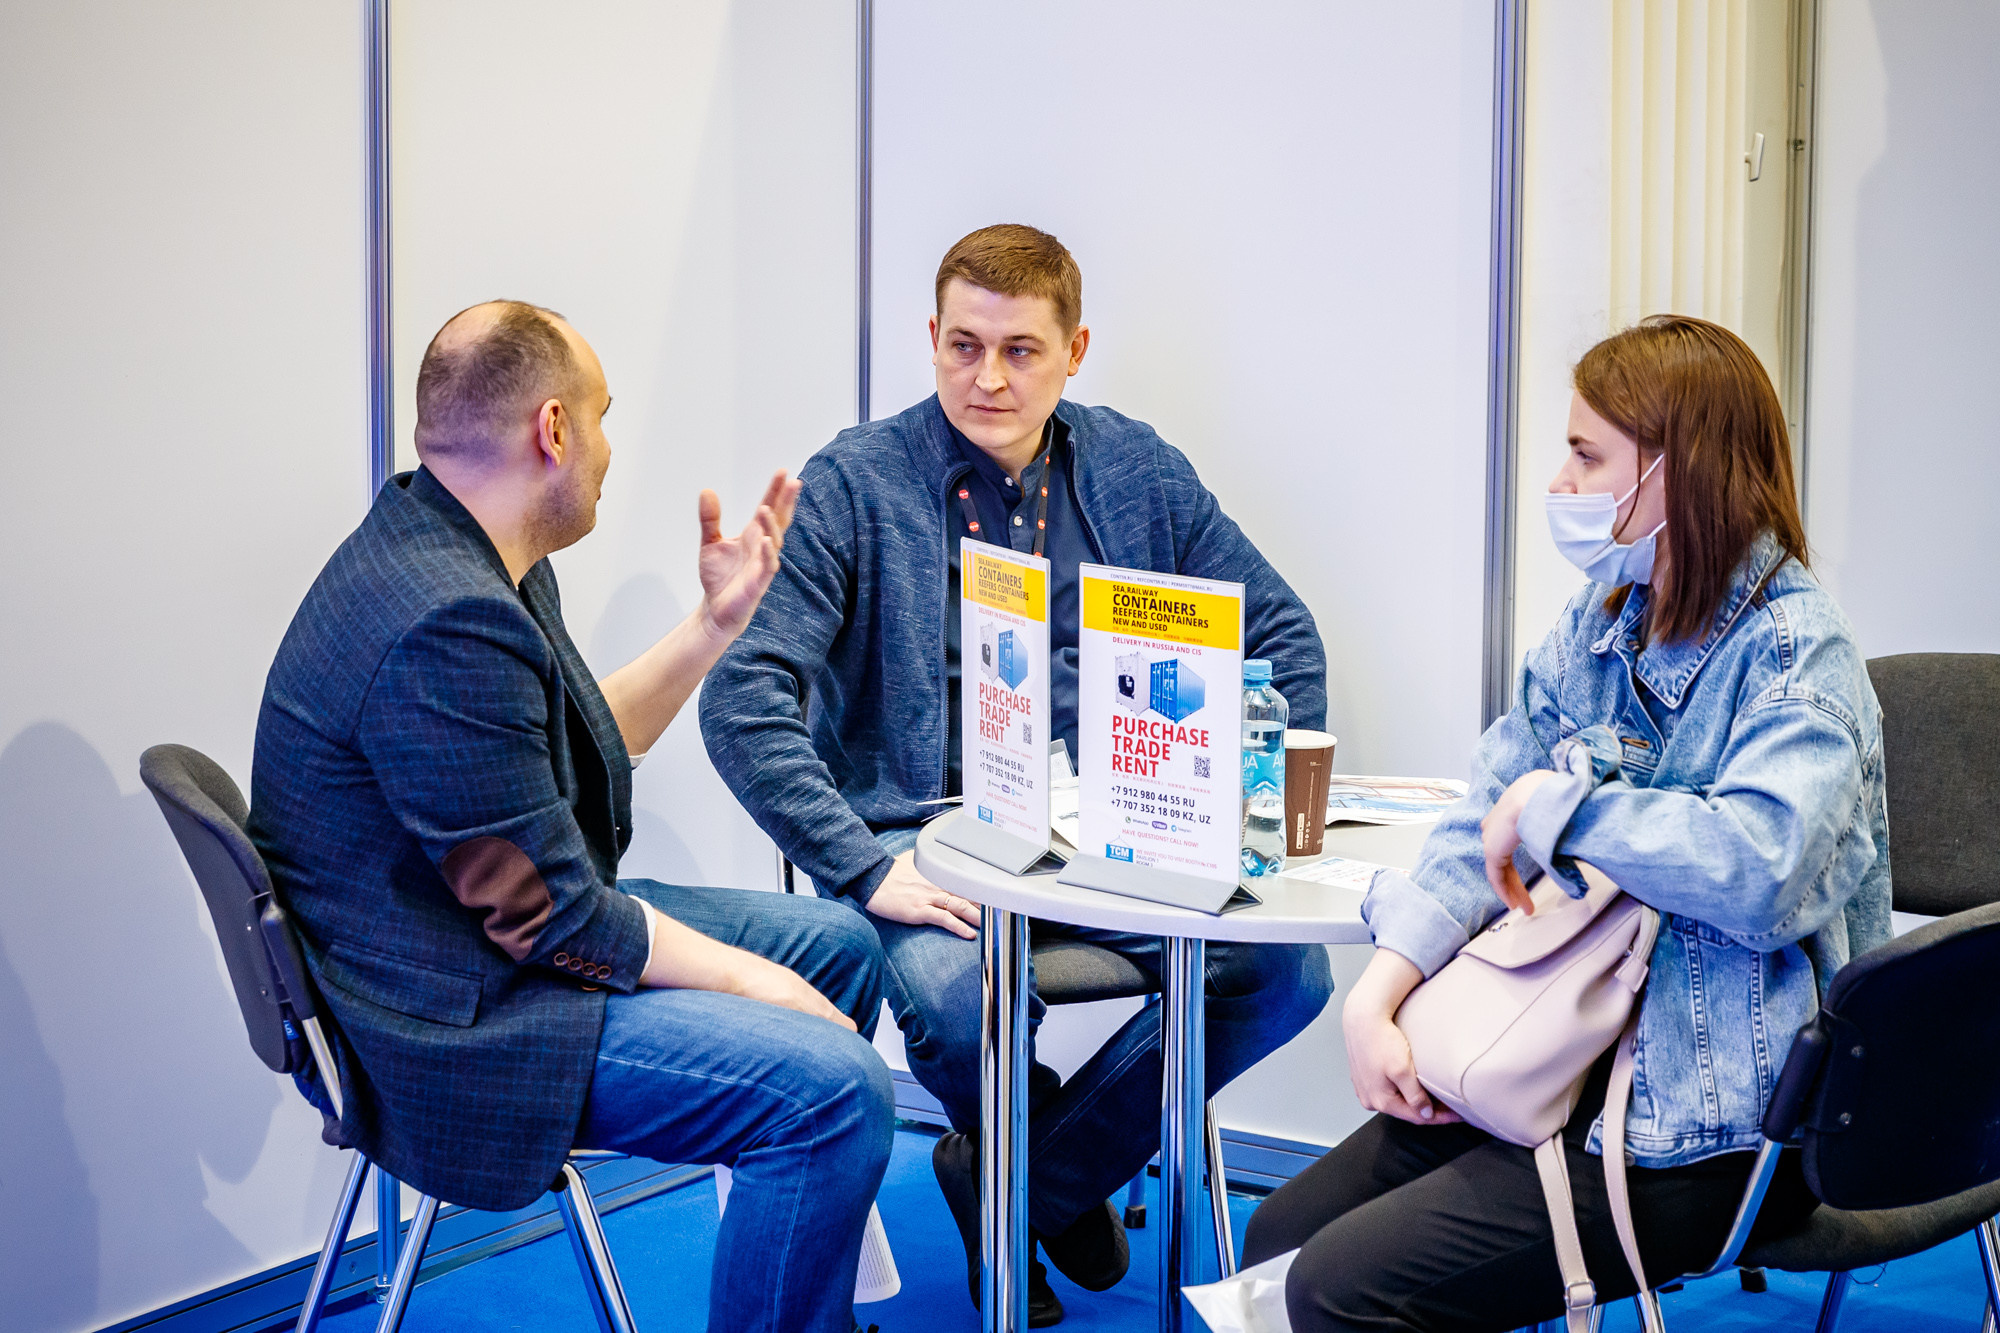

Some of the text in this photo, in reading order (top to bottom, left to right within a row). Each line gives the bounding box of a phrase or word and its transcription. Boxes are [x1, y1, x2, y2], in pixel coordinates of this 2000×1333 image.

[978, 566, 1022, 589] CONTAINERS
[978, 578, 1029, 601] REEFERS CONTAINERS
[978, 588, 1007, 603] NEW AND USED
[978, 606, 994, 617] DELIVERY
[1113, 593, 1196, 616] CONTAINERS
[1113, 607, 1209, 628] REEFERS CONTAINERS
[1113, 618, 1168, 632] NEW AND USED
[1112, 636, 1141, 646] DELIVERY
[1152, 643, 1174, 651] RUSSIA
[1176, 646, 1190, 654] AND
[1192, 648, 1202, 656] CIS
[979, 682, 1030, 715] PURCHASE
[979, 700, 1010, 727] TRADE
[980, 718, 1004, 743] RENT
[1113, 715, 1209, 748] PURCHASE
[1112, 734, 1170, 760] TRADE
[986, 751, 994, 761] 912
[1004, 758, 1010, 767] 44
[1011, 760, 1016, 770] 55
[1018, 762, 1024, 773] RU
[1112, 754, 1159, 777] RENT
[980, 762, 985, 770] +7
[995, 767, 1003, 778] 352
[1004, 771, 1010, 780] 18
[1026, 779, 1033, 789] UZ
[1111, 786, 1195, 808] +7 912 980 44 55 RU
[1111, 799, 1211, 824] +7 707 352 18 09 KZ, UZ
[1122, 828, 1198, 848] HAVE QUESTIONS? CALL NOW!
[1110, 845, 1130, 858] TCM
